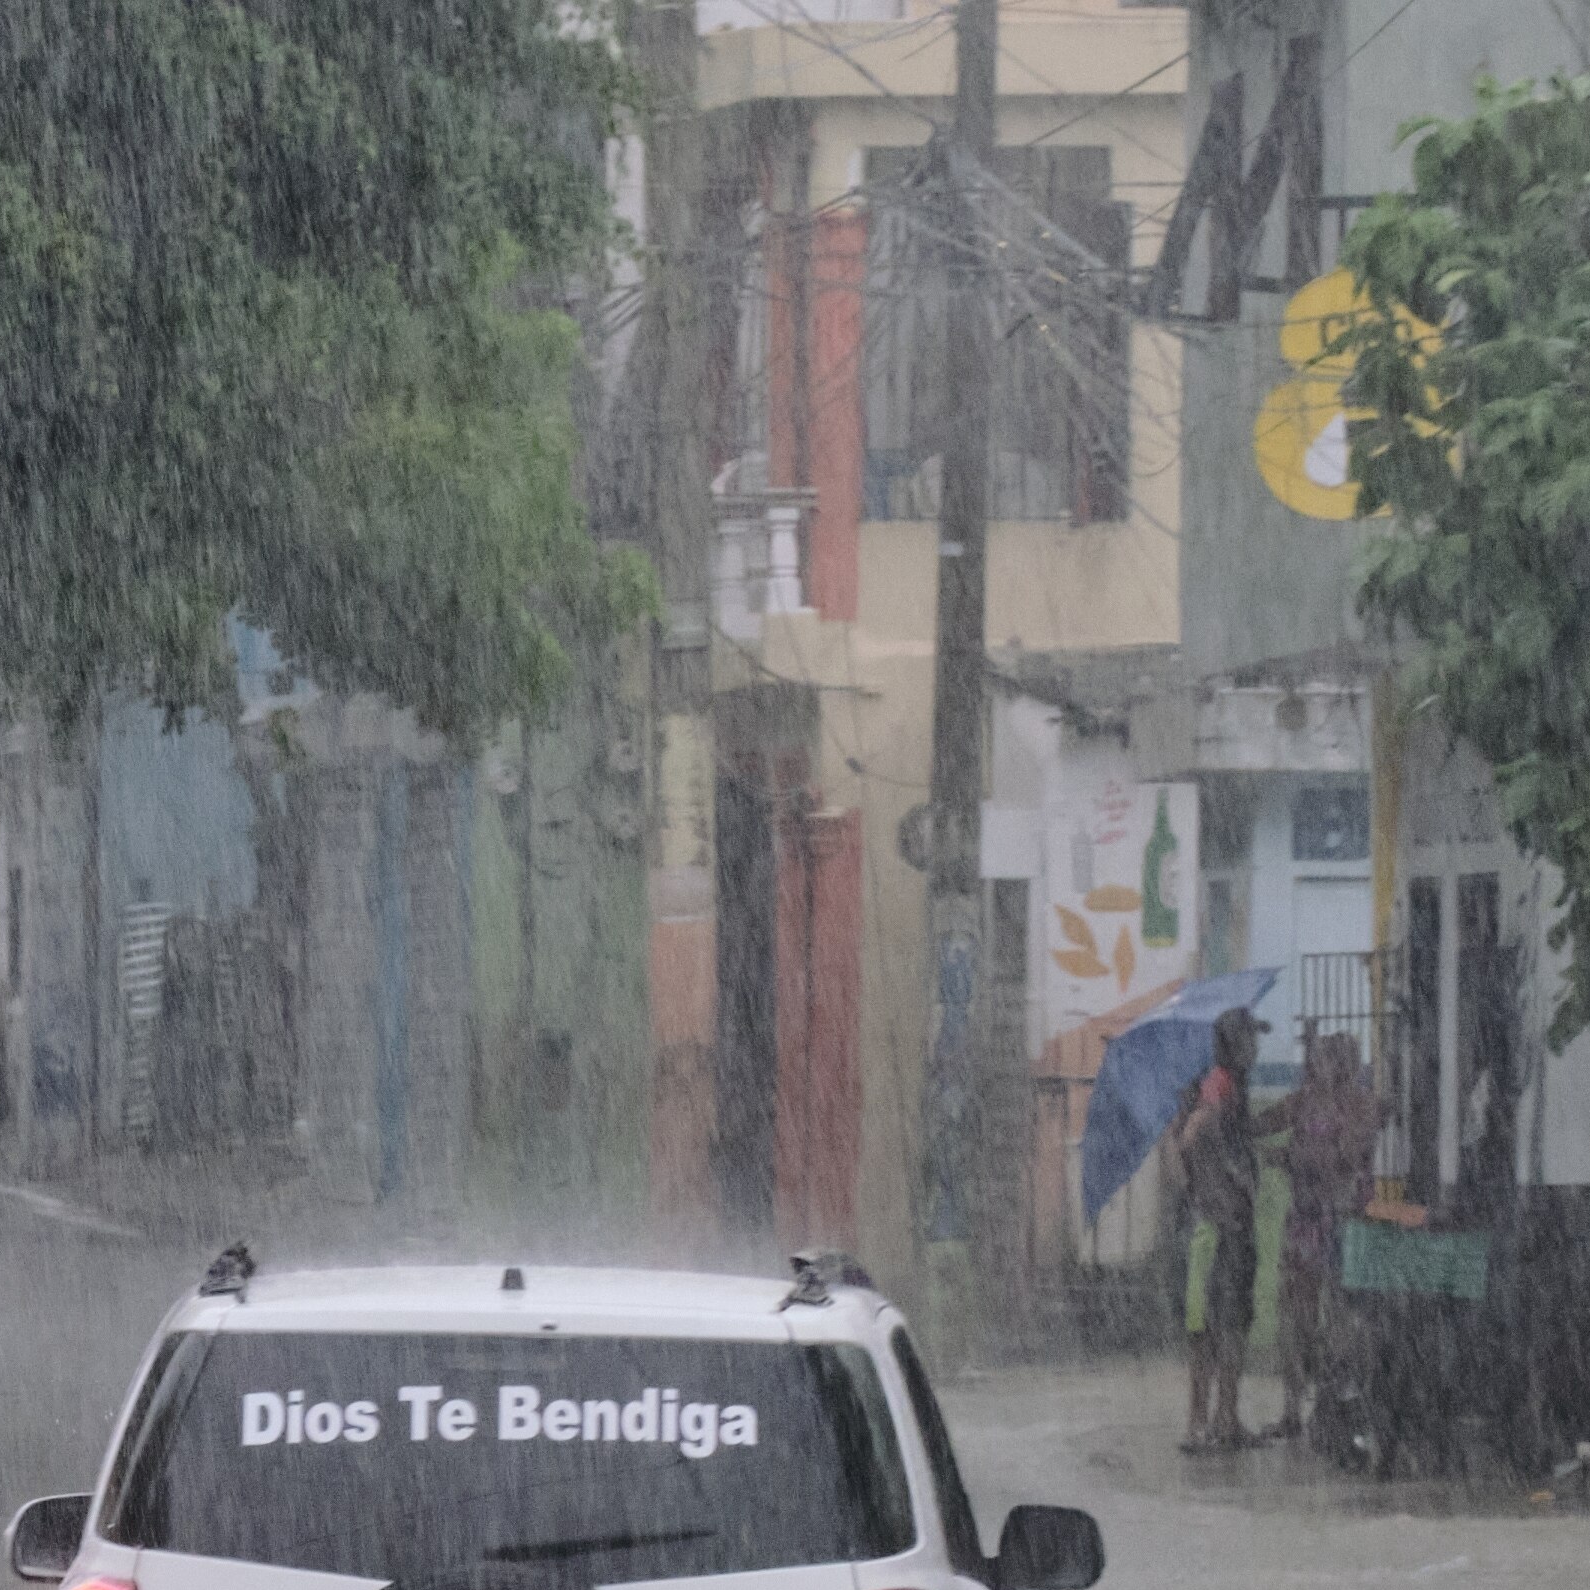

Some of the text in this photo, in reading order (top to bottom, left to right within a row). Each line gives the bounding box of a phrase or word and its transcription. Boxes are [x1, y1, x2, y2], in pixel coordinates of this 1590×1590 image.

[242, 1385, 759, 1459] Dios Te Bendiga
